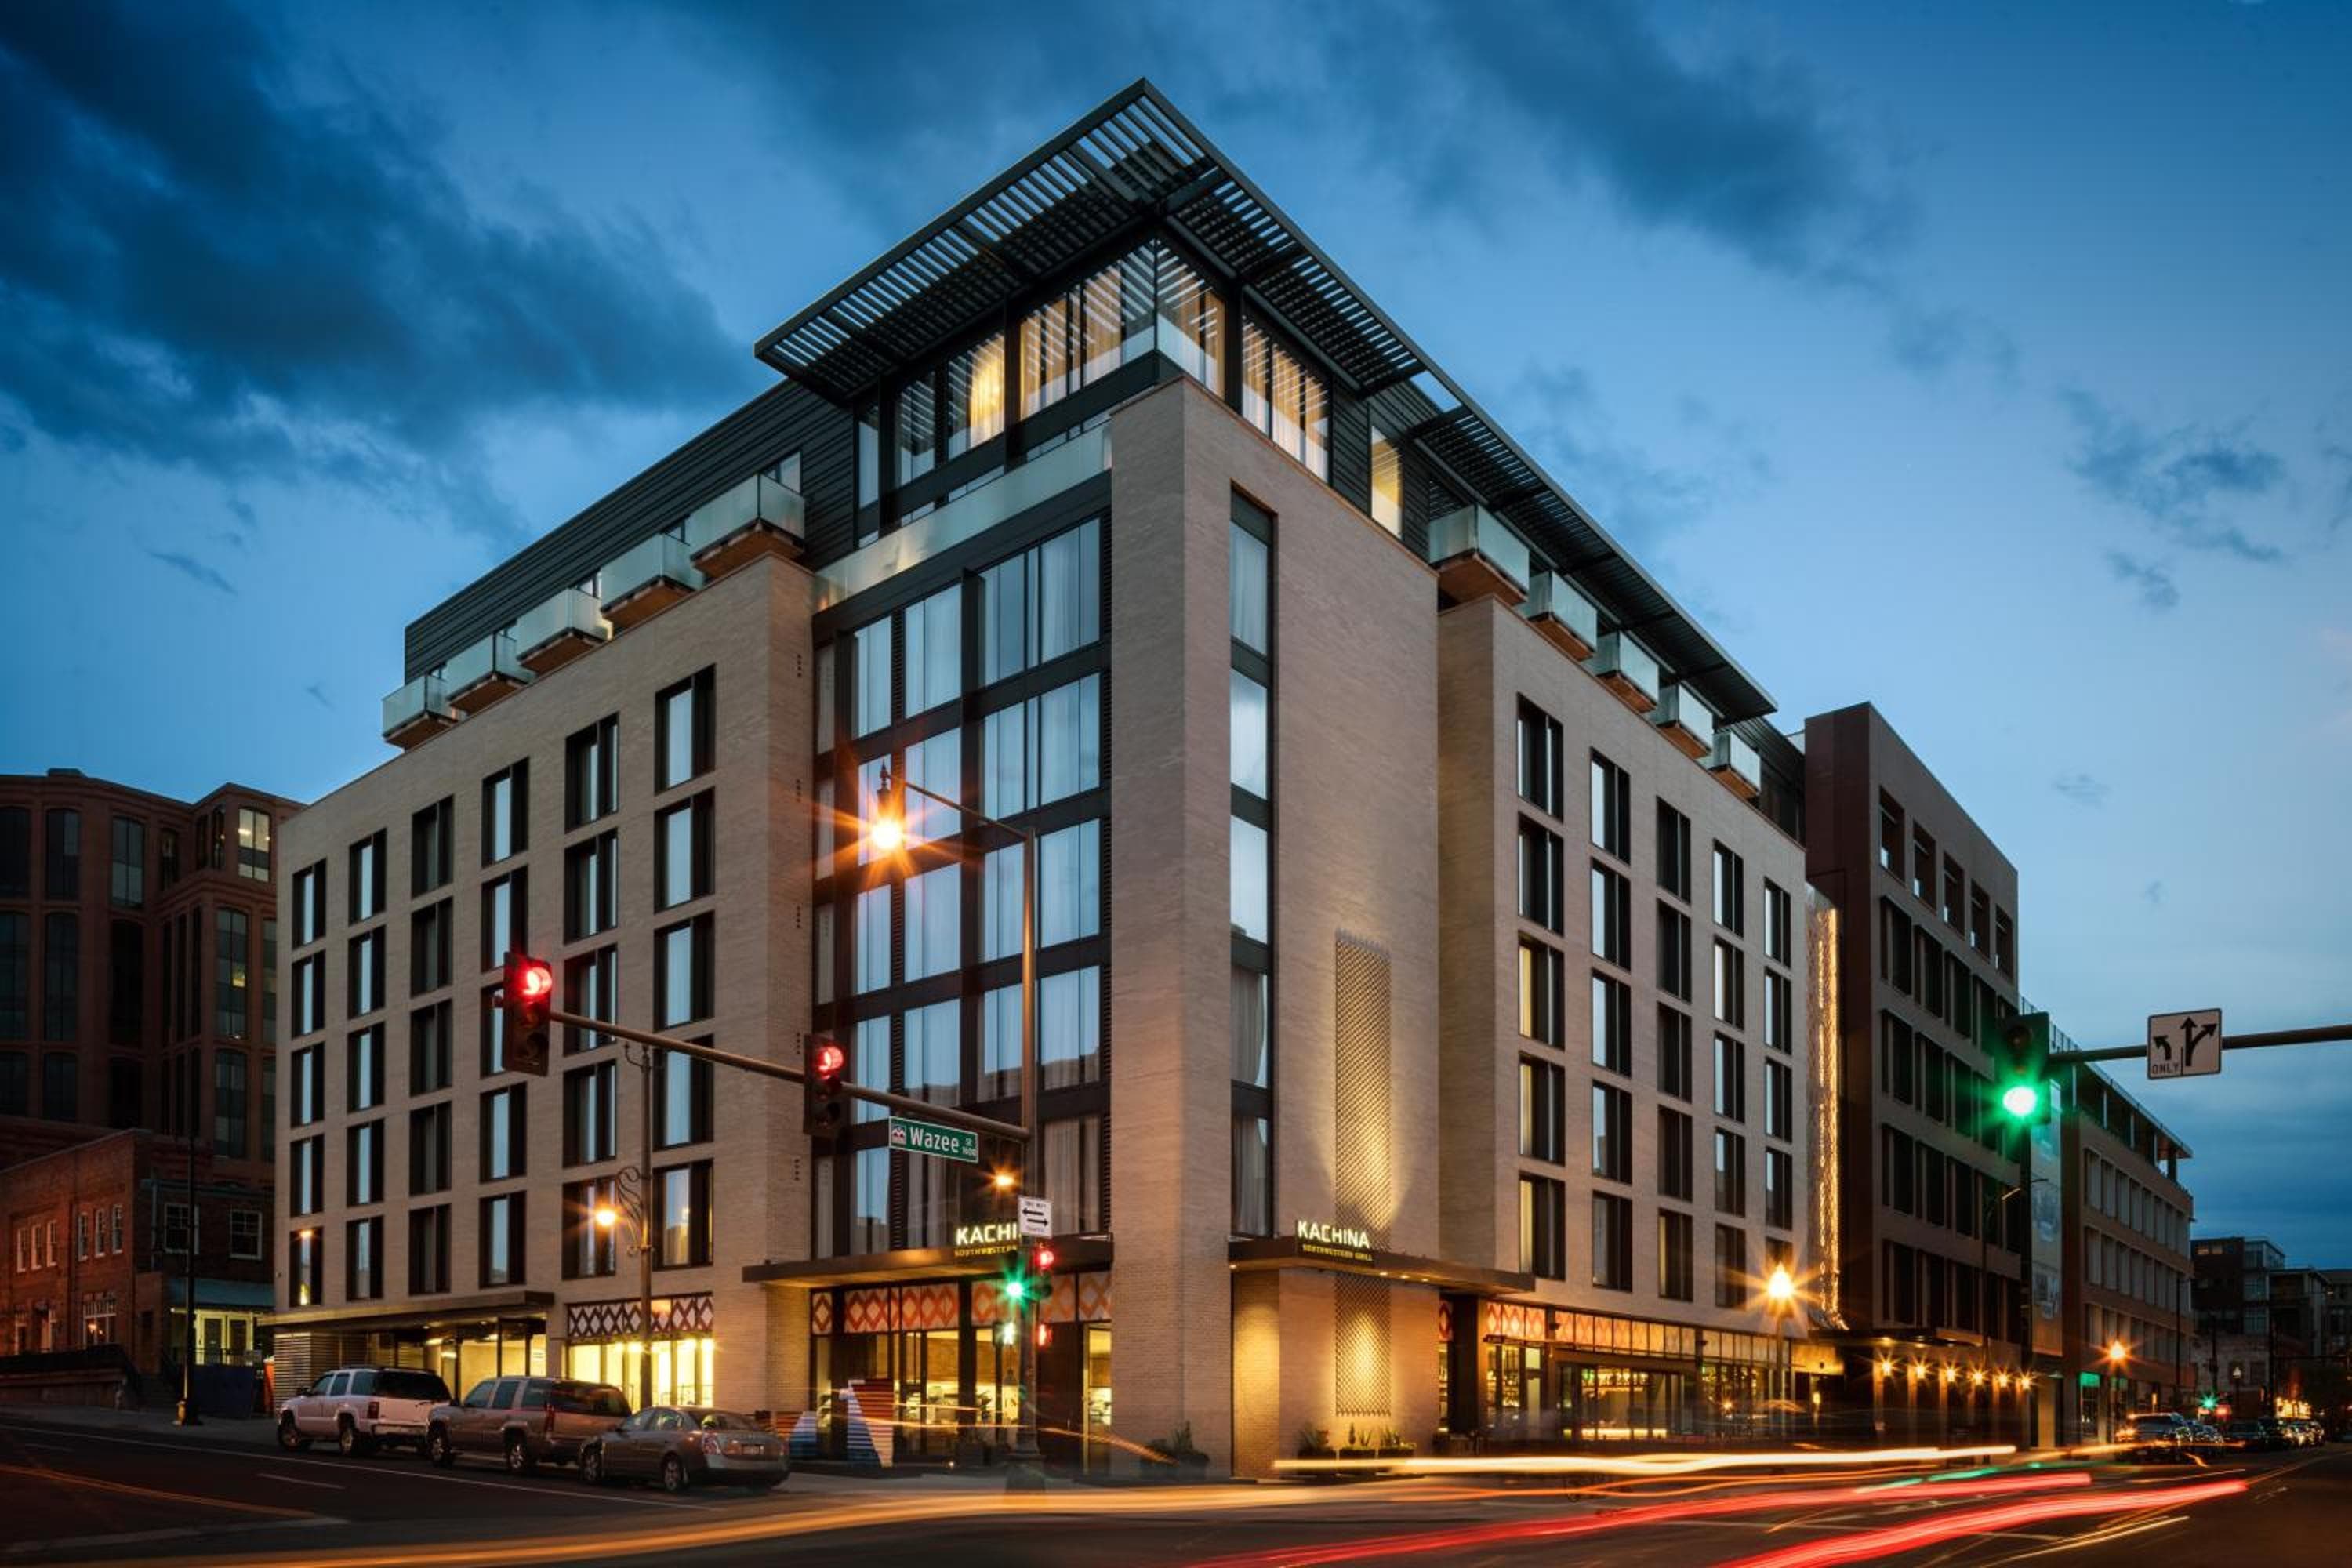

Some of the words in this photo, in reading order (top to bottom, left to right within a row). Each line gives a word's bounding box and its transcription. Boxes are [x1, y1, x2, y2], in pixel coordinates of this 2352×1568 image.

[2153, 1063, 2179, 1074] ONLY
[909, 1127, 960, 1153] Wazee
[956, 1222, 1022, 1246] KACHI
[1298, 1221, 1370, 1248] KACHINA
